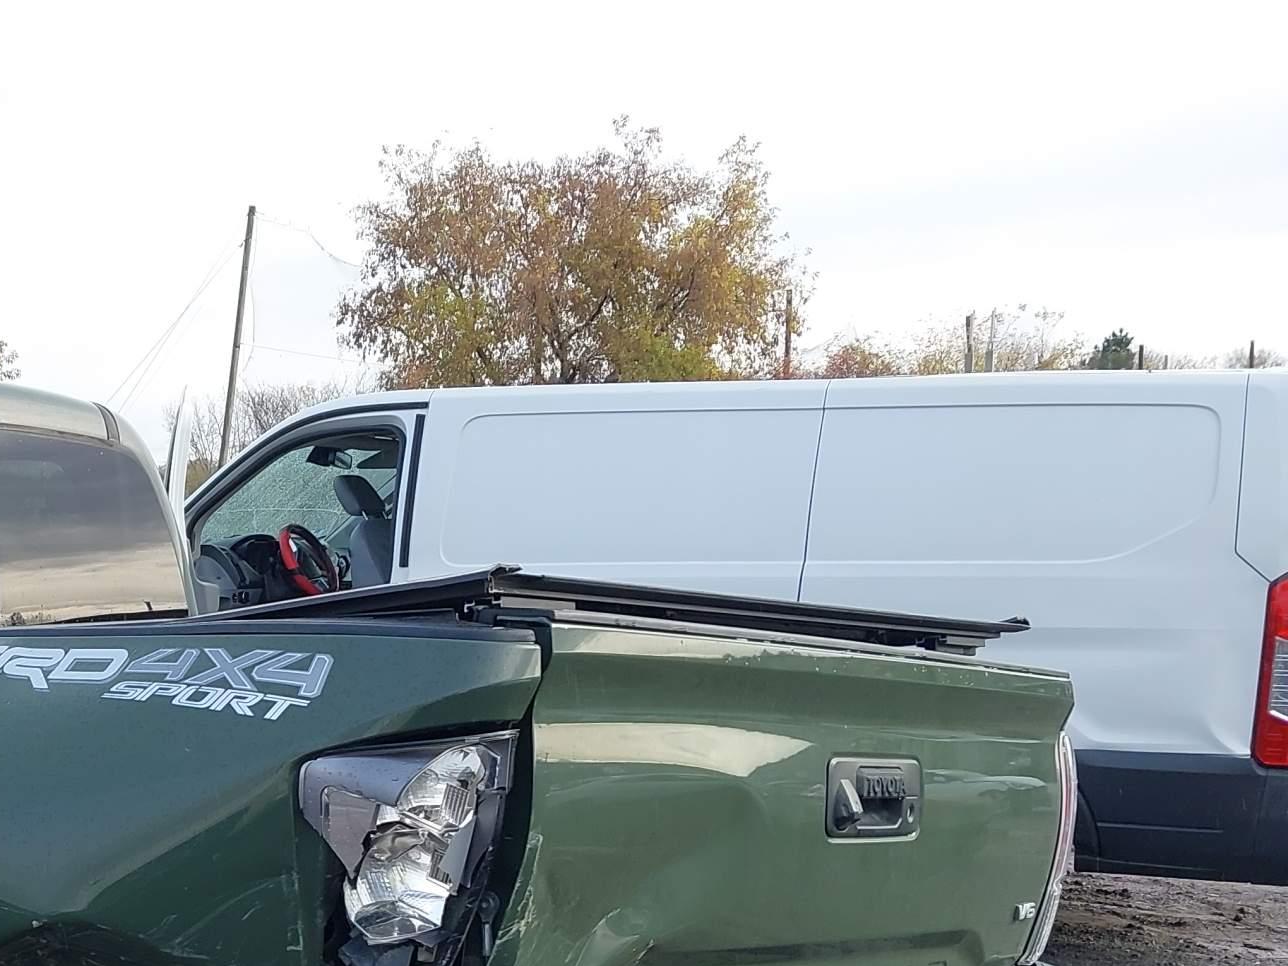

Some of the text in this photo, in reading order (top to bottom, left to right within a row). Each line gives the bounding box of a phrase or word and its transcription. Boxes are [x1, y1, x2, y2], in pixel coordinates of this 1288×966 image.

[100, 681, 311, 721] SPORT
[863, 775, 906, 799] TOYOTA
[1014, 902, 1036, 920] V6
